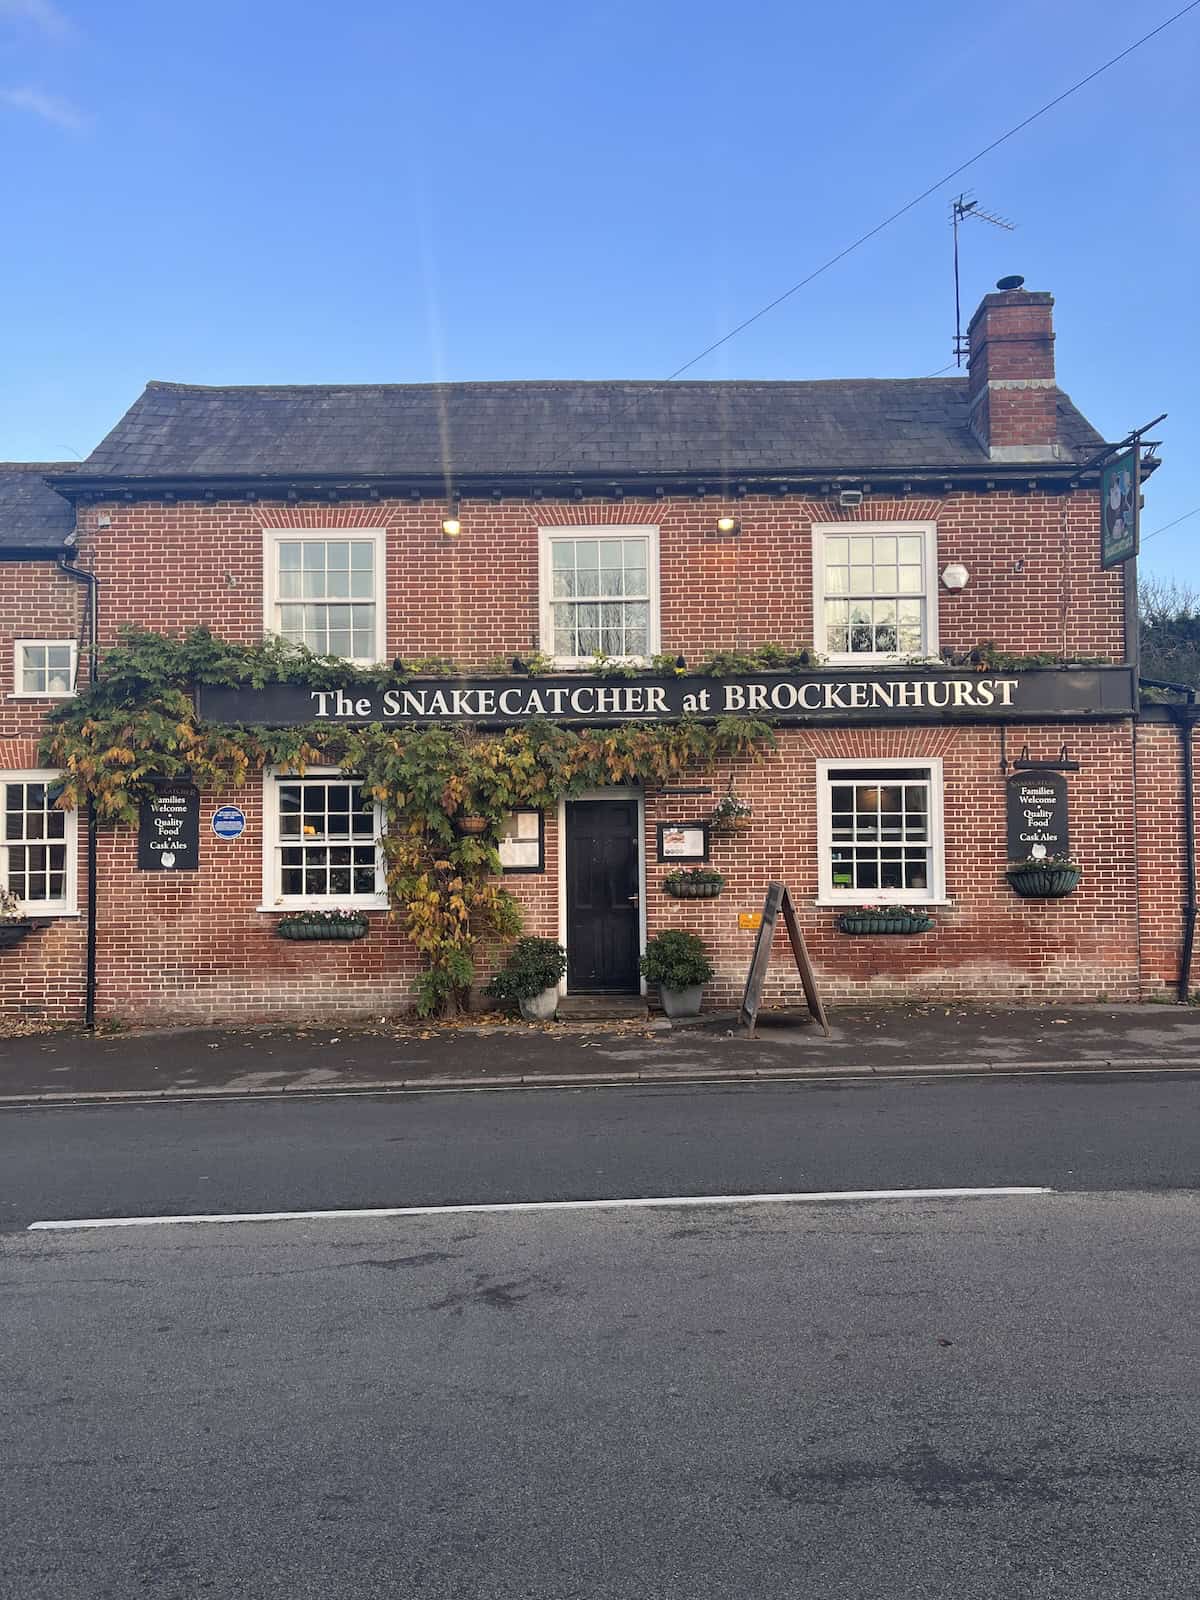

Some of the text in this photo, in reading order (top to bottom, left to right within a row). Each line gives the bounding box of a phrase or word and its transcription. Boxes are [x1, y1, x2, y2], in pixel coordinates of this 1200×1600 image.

[311, 679, 1018, 717] The SNAKECATCHER at BROCKENHURST
[1021, 786, 1054, 795] Families
[152, 795, 185, 804] amilies
[1020, 795, 1056, 804] Welcome
[150, 804, 187, 812] Welcome
[1023, 809, 1053, 819] Quality
[154, 818, 183, 829] Quality
[1028, 818, 1048, 827] Food
[158, 827, 179, 835] Food
[1020, 833, 1058, 841] Cask Ales
[150, 841, 187, 849] Cask Ales
